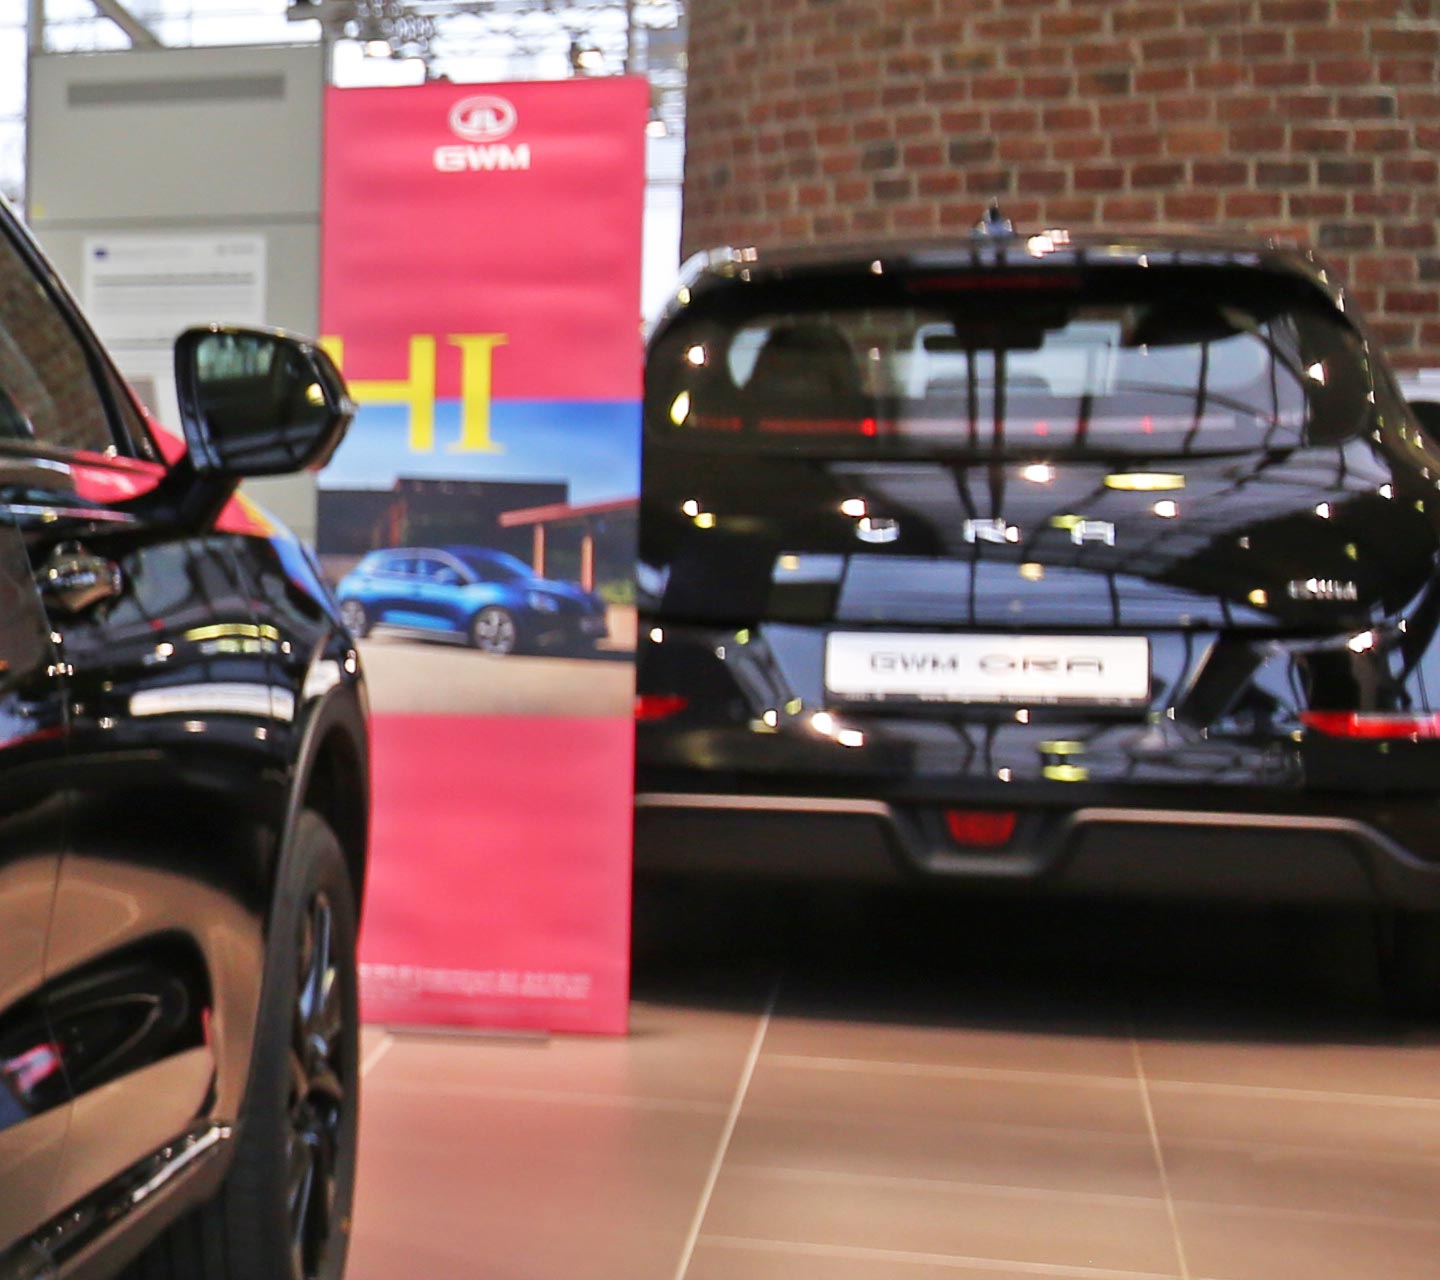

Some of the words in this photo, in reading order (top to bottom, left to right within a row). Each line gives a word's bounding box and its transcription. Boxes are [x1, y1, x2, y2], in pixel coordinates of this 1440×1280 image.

[434, 144, 531, 171] GWM
[871, 651, 960, 675] GWM
[979, 654, 1104, 678] ORA
